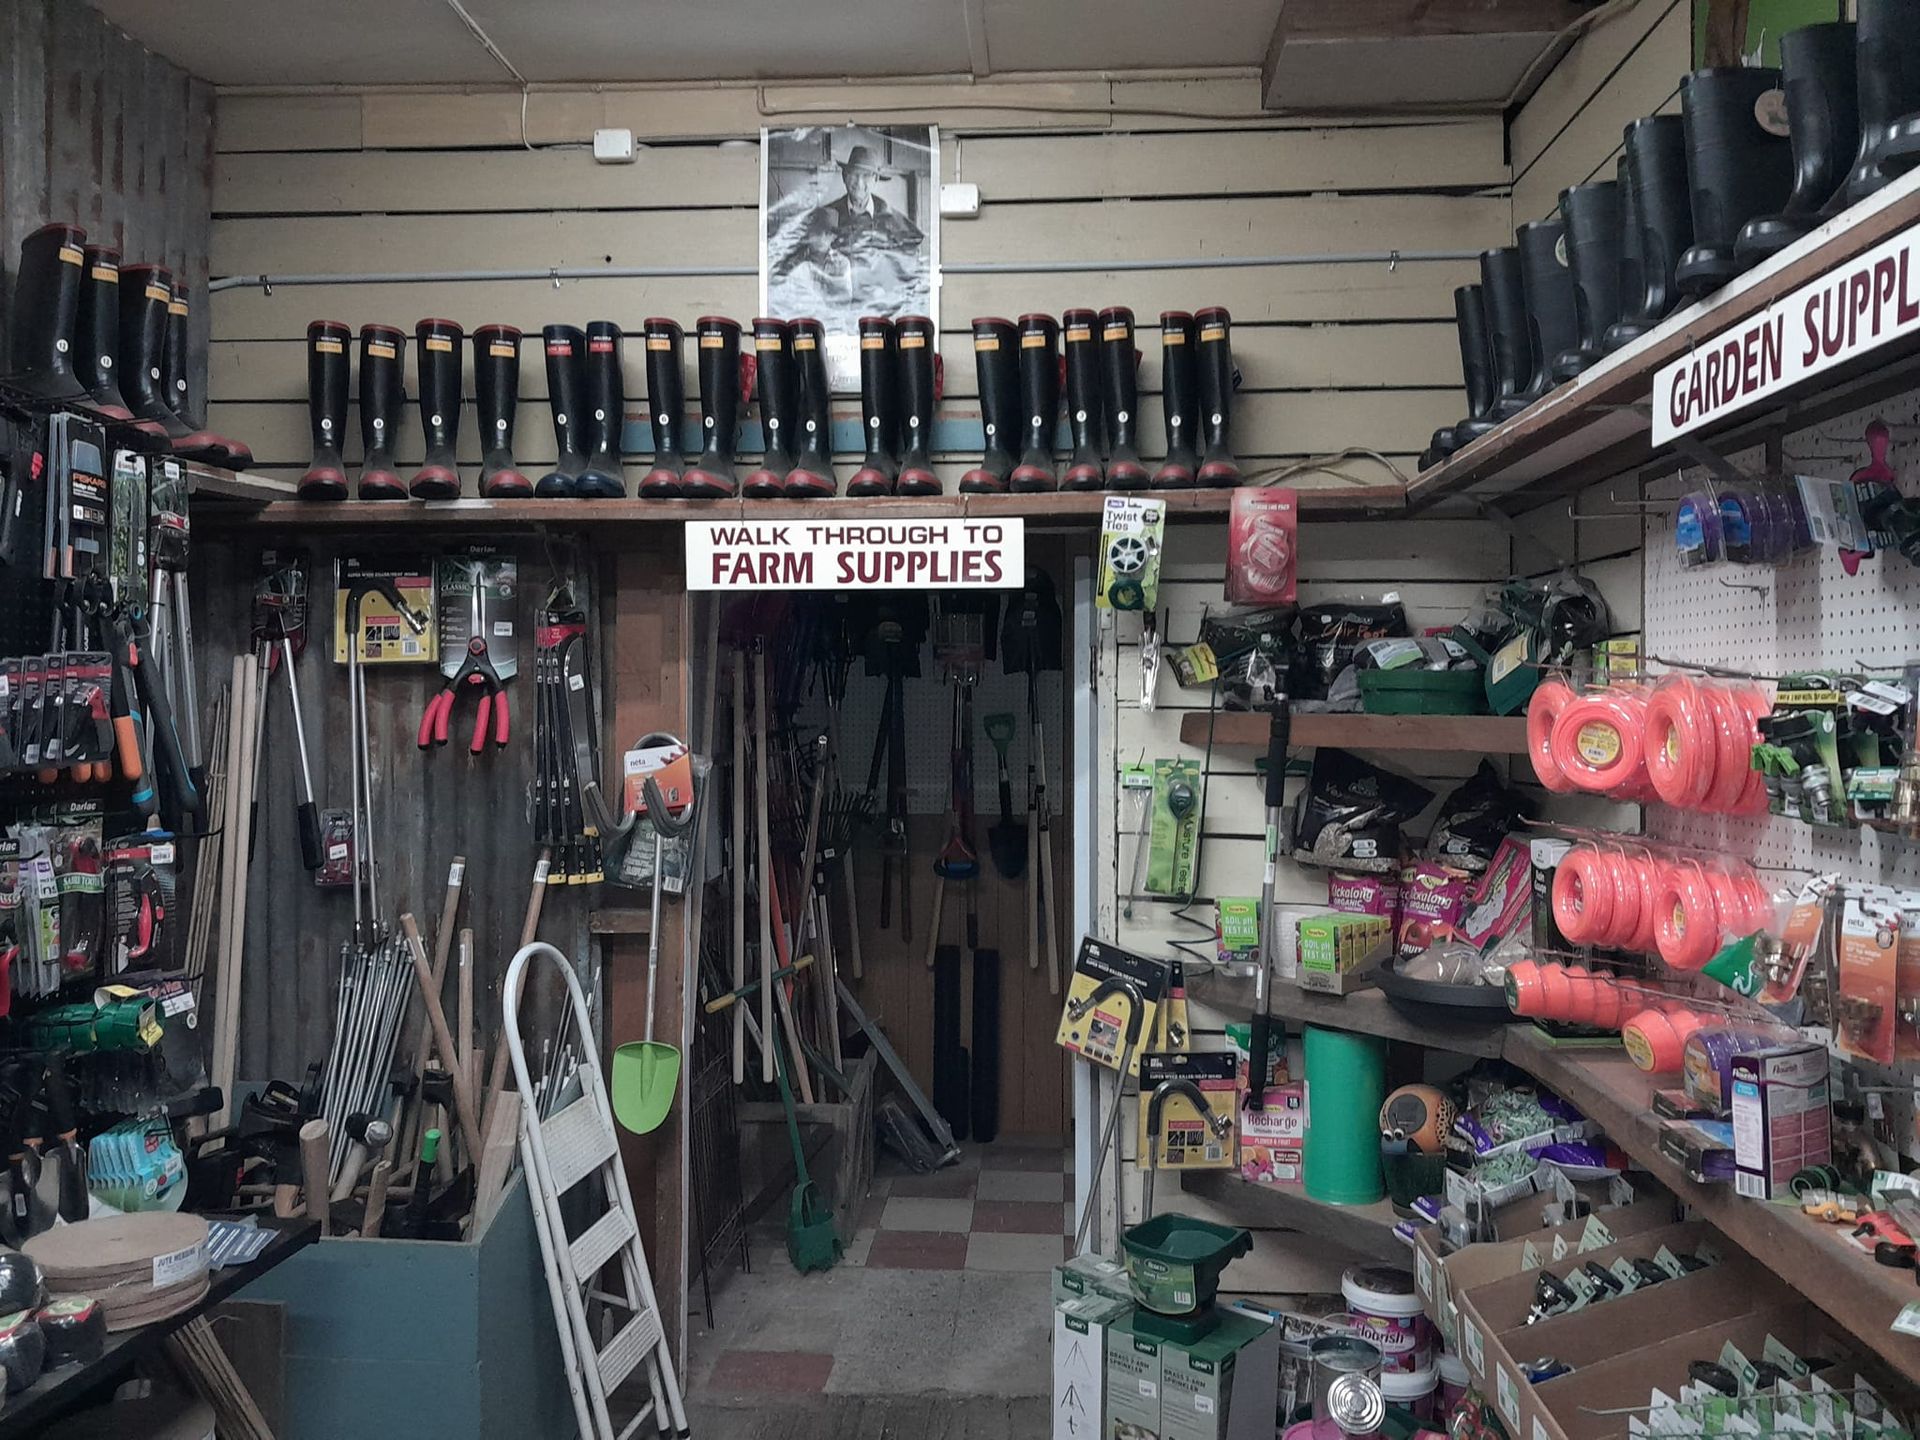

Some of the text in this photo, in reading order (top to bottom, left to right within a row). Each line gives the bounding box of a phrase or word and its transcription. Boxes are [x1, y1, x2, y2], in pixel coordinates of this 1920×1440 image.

[1670, 246, 1920, 428] GARDEN SUPPL
[73, 472, 106, 489] FISKARS
[1106, 510, 1137, 522] Twist
[1106, 520, 1128, 531] Ties
[710, 525, 1003, 546] WALK THROUGH TO
[712, 550, 1002, 584] FARM SUPPLIES
[441, 582, 470, 592] CLASSIC
[630, 759, 646, 767] neta
[70, 802, 96, 812] Darlac
[1242, 918, 1252, 926] pH
[1320, 942, 1330, 950] pH
[1248, 1114, 1298, 1129] Recharge
[158, 1256, 172, 1268] JUTE
[1109, 1358, 1143, 1374] SPRINKLER
[1164, 1375, 1199, 1393] SPRINKLER
